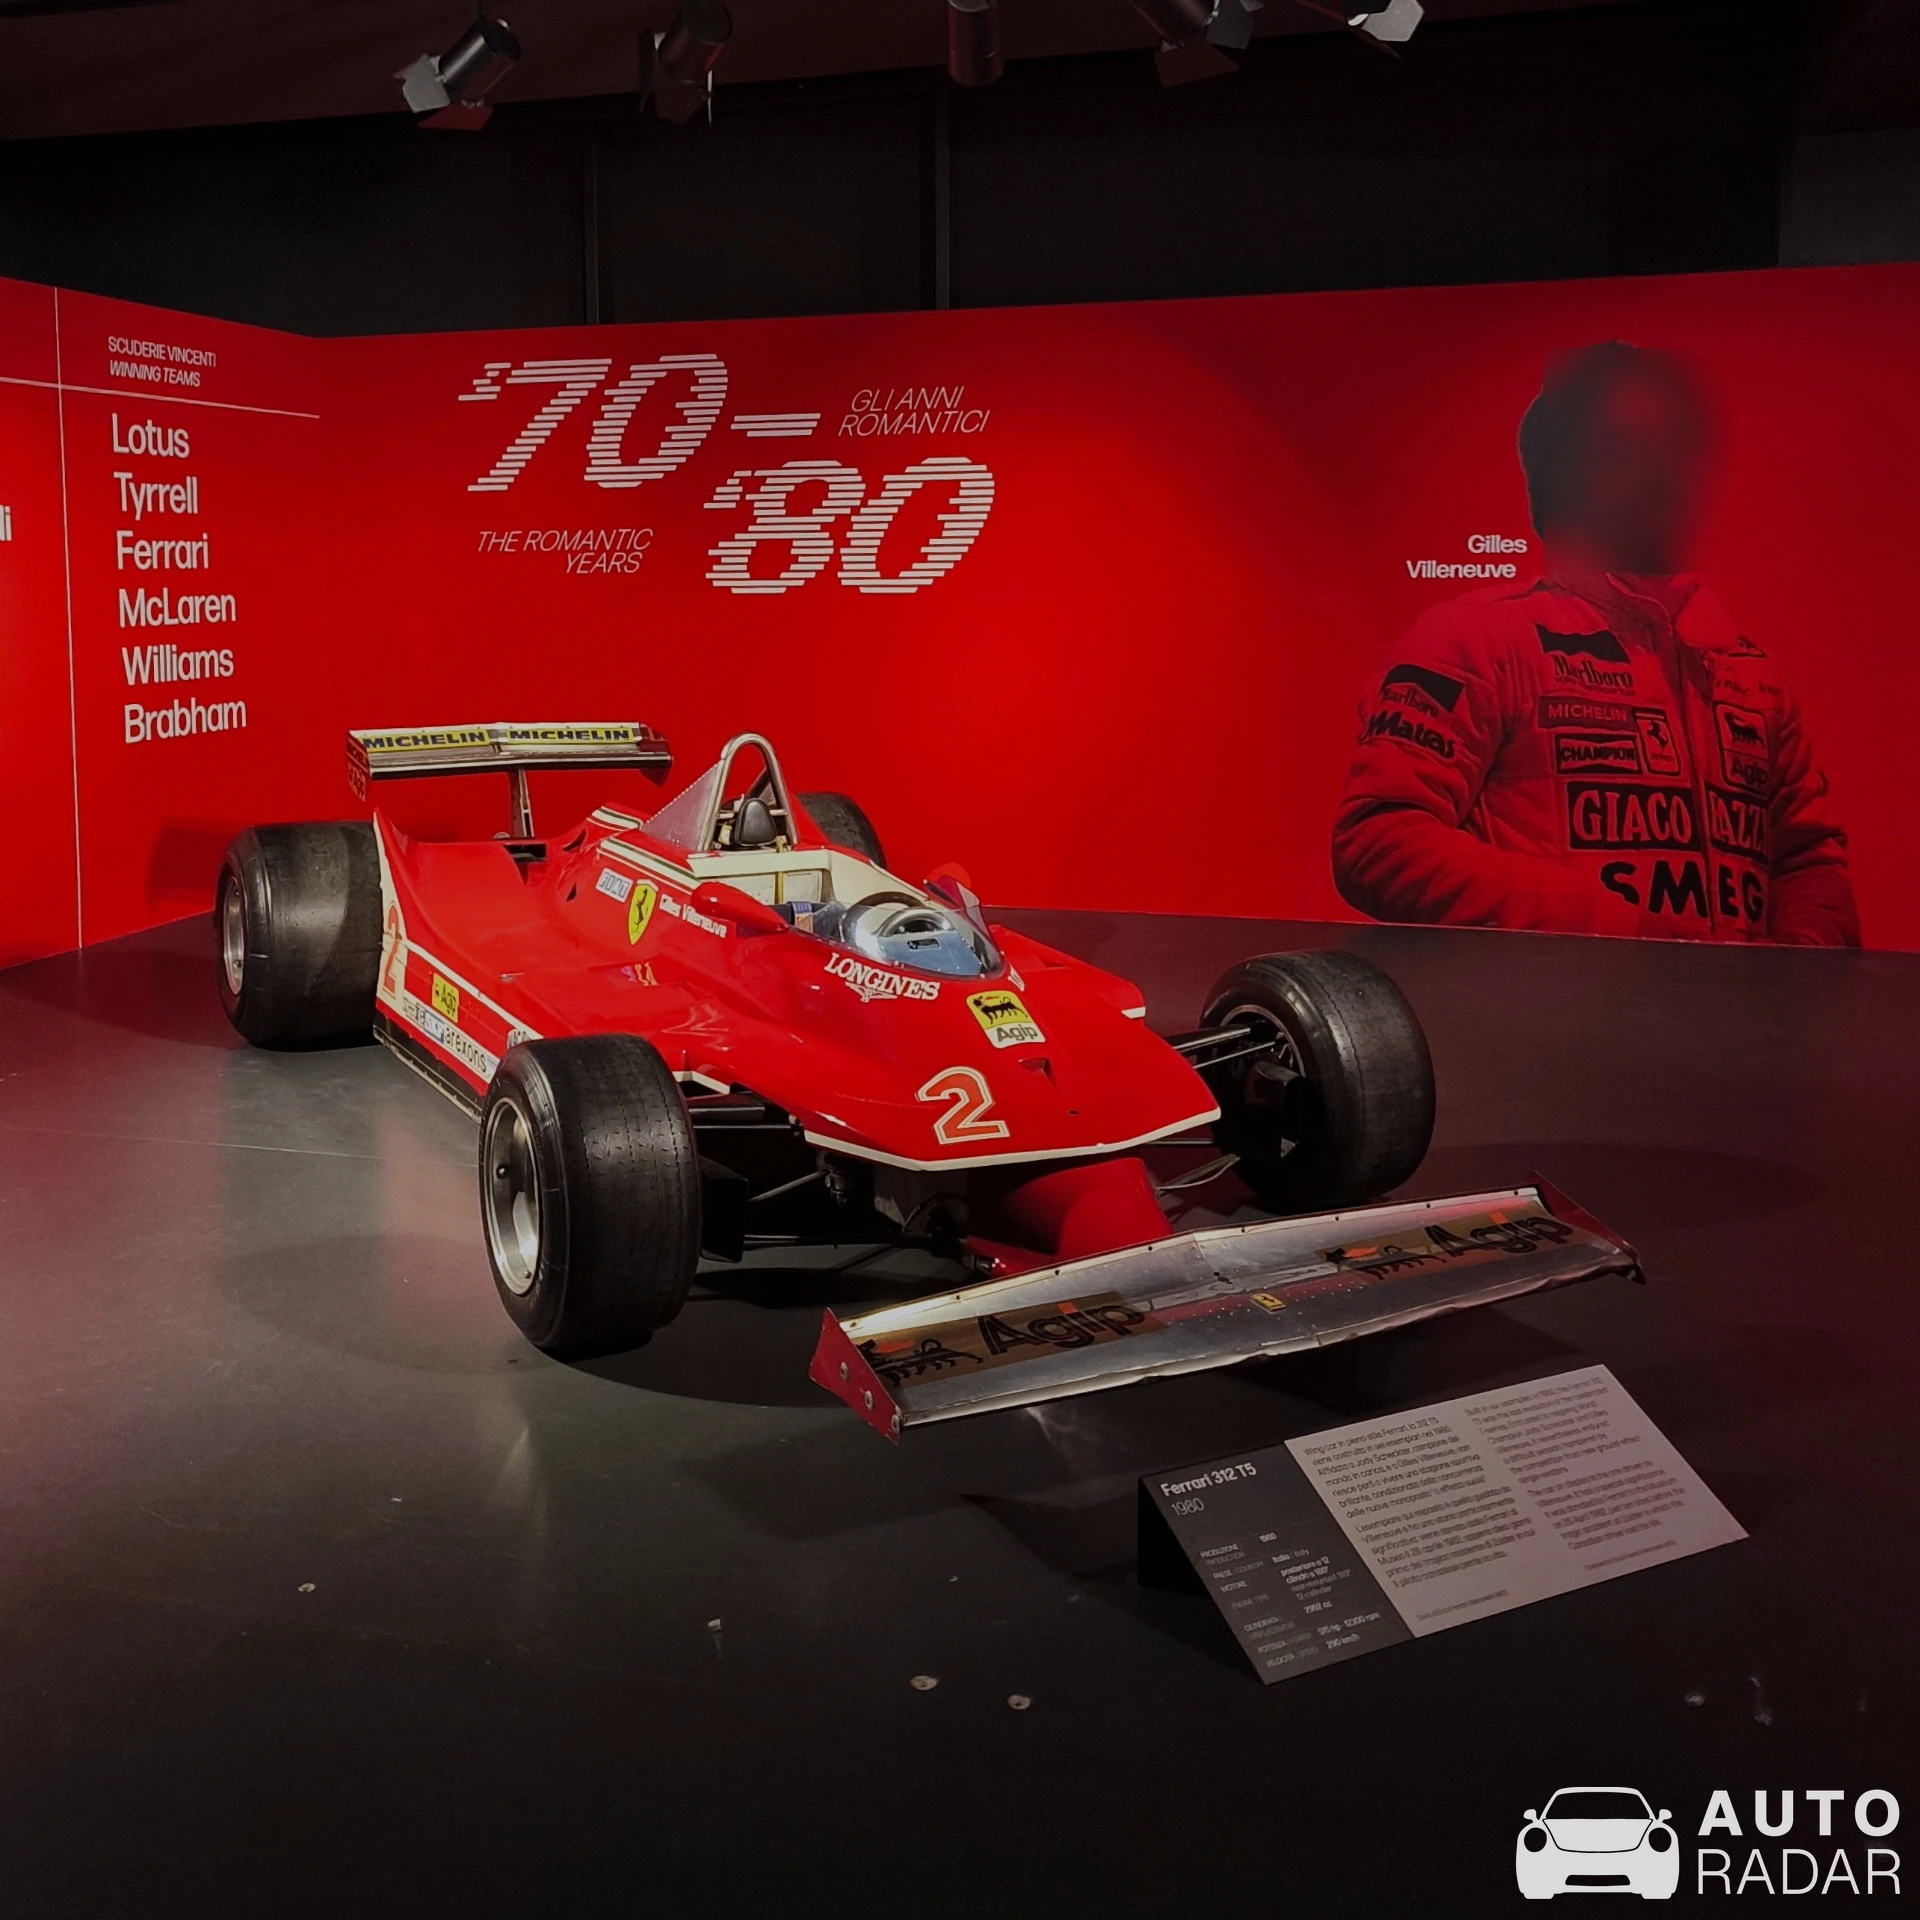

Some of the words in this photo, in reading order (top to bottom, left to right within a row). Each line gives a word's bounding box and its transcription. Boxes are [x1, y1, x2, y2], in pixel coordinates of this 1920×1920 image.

[108, 336, 166, 360] SCUDERIE
[167, 346, 216, 367] VINCENTI
[109, 360, 161, 382] WINNING
[164, 369, 201, 387] TEAMS
[850, 388, 895, 412] GLI
[896, 386, 965, 410] ANNI
[112, 413, 190, 458] Lotus
[838, 410, 990, 437] ROMANTICI
[113, 471, 199, 521] Tyrrell
[116, 529, 210, 570] Ferrari
[477, 530, 523, 552] THE
[523, 528, 653, 552] ROMANTIC
[1467, 534, 1528, 555] Gilles
[566, 552, 643, 574] YEARS
[1406, 559, 1517, 579] Villeneuve
[118, 587, 237, 628] McLaren
[121, 643, 235, 686] Williams
[1551, 655, 1634, 688] Marlboro
[124, 697, 247, 744] Brabham
[1547, 703, 1628, 722] MICHELIN
[362, 731, 486, 749] MICHELIN
[508, 728, 630, 741] MICHELIN
[1560, 745, 1636, 763] CHAMPION
[1599, 859, 1765, 923] SMEG
[824, 952, 940, 1001] LONGINES
[996, 1024, 1038, 1041] Agip
[446, 1027, 487, 1073] arexons
[915, 1066, 1010, 1144] 2
[1424, 1210, 1574, 1258] Agip
[975, 1302, 1146, 1356] Agip
[1160, 1474, 1213, 1497] Ferrari
[1210, 1468, 1238, 1484] 312
[1236, 1463, 1258, 1477] T5
[1324, 1475, 1353, 1486] mondo
[1170, 1497, 1206, 1517] 1980
